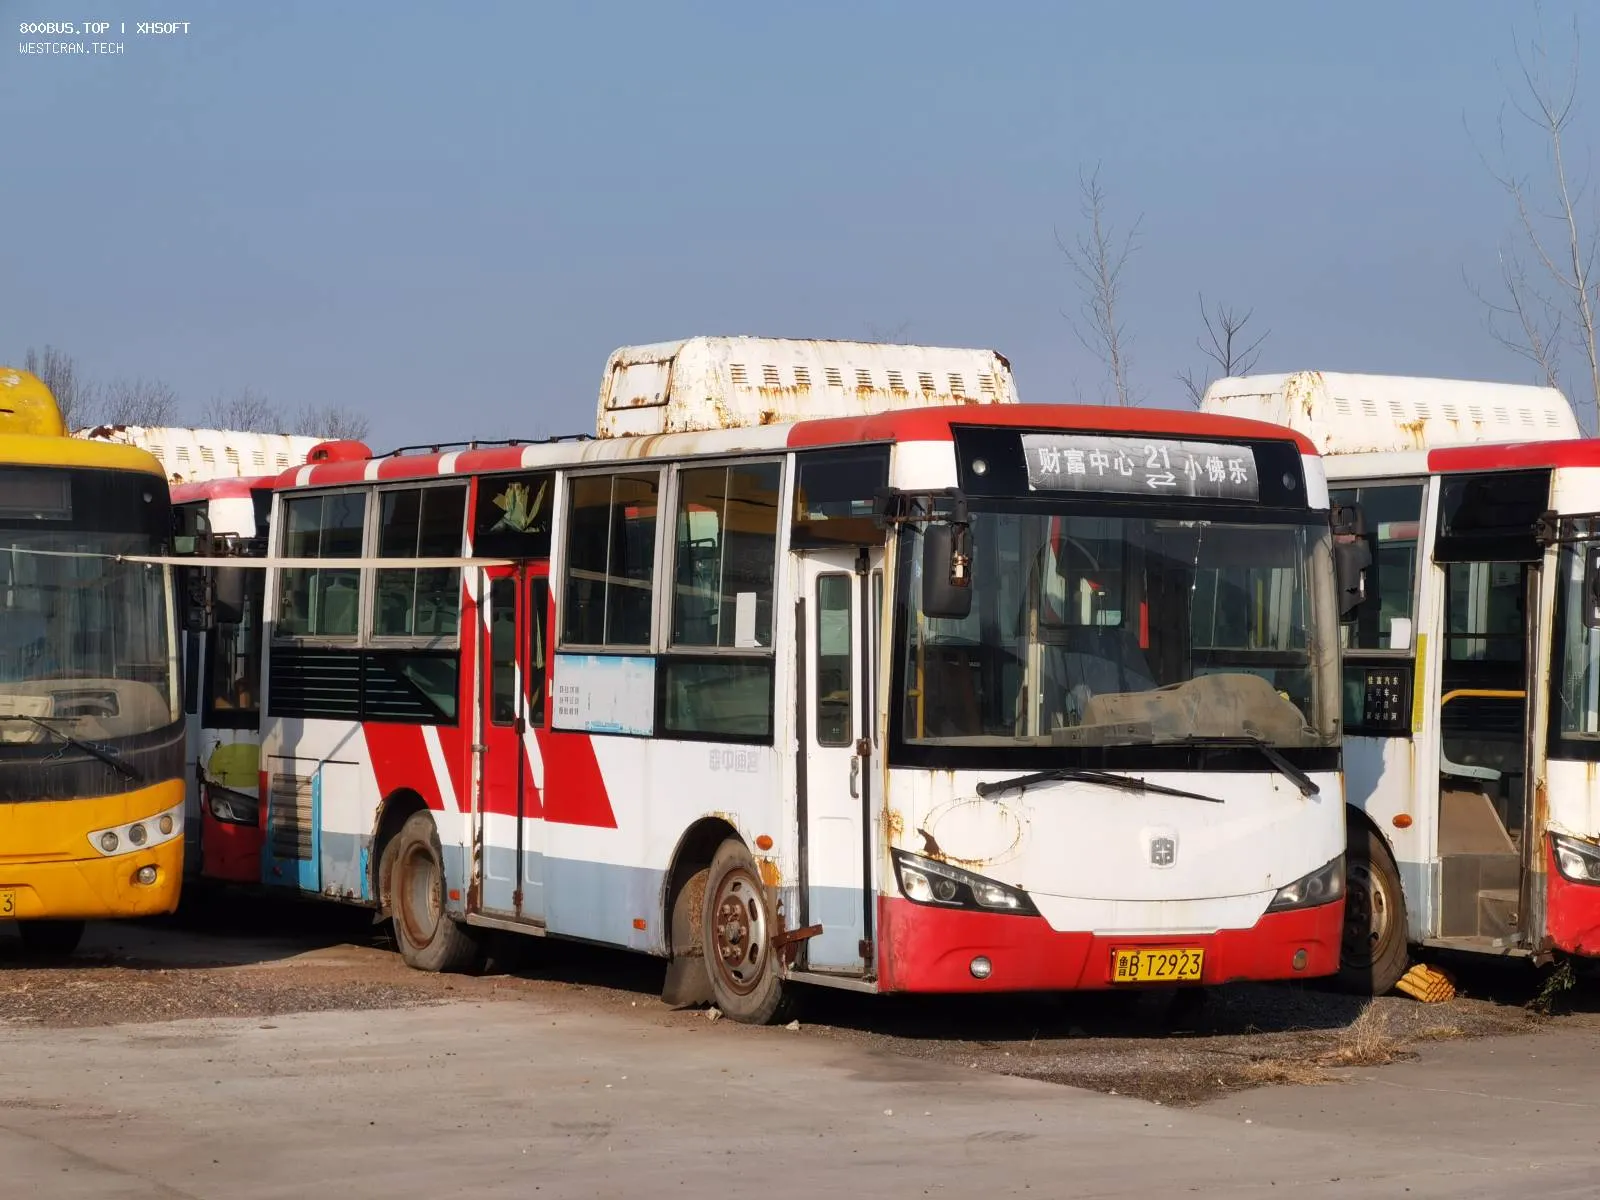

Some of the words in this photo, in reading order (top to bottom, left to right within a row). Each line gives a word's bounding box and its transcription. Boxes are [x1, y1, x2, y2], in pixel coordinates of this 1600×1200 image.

[1038, 447, 1134, 477] 财富中心
[1144, 444, 1171, 469] 21
[1184, 454, 1248, 485] 小佛乐
